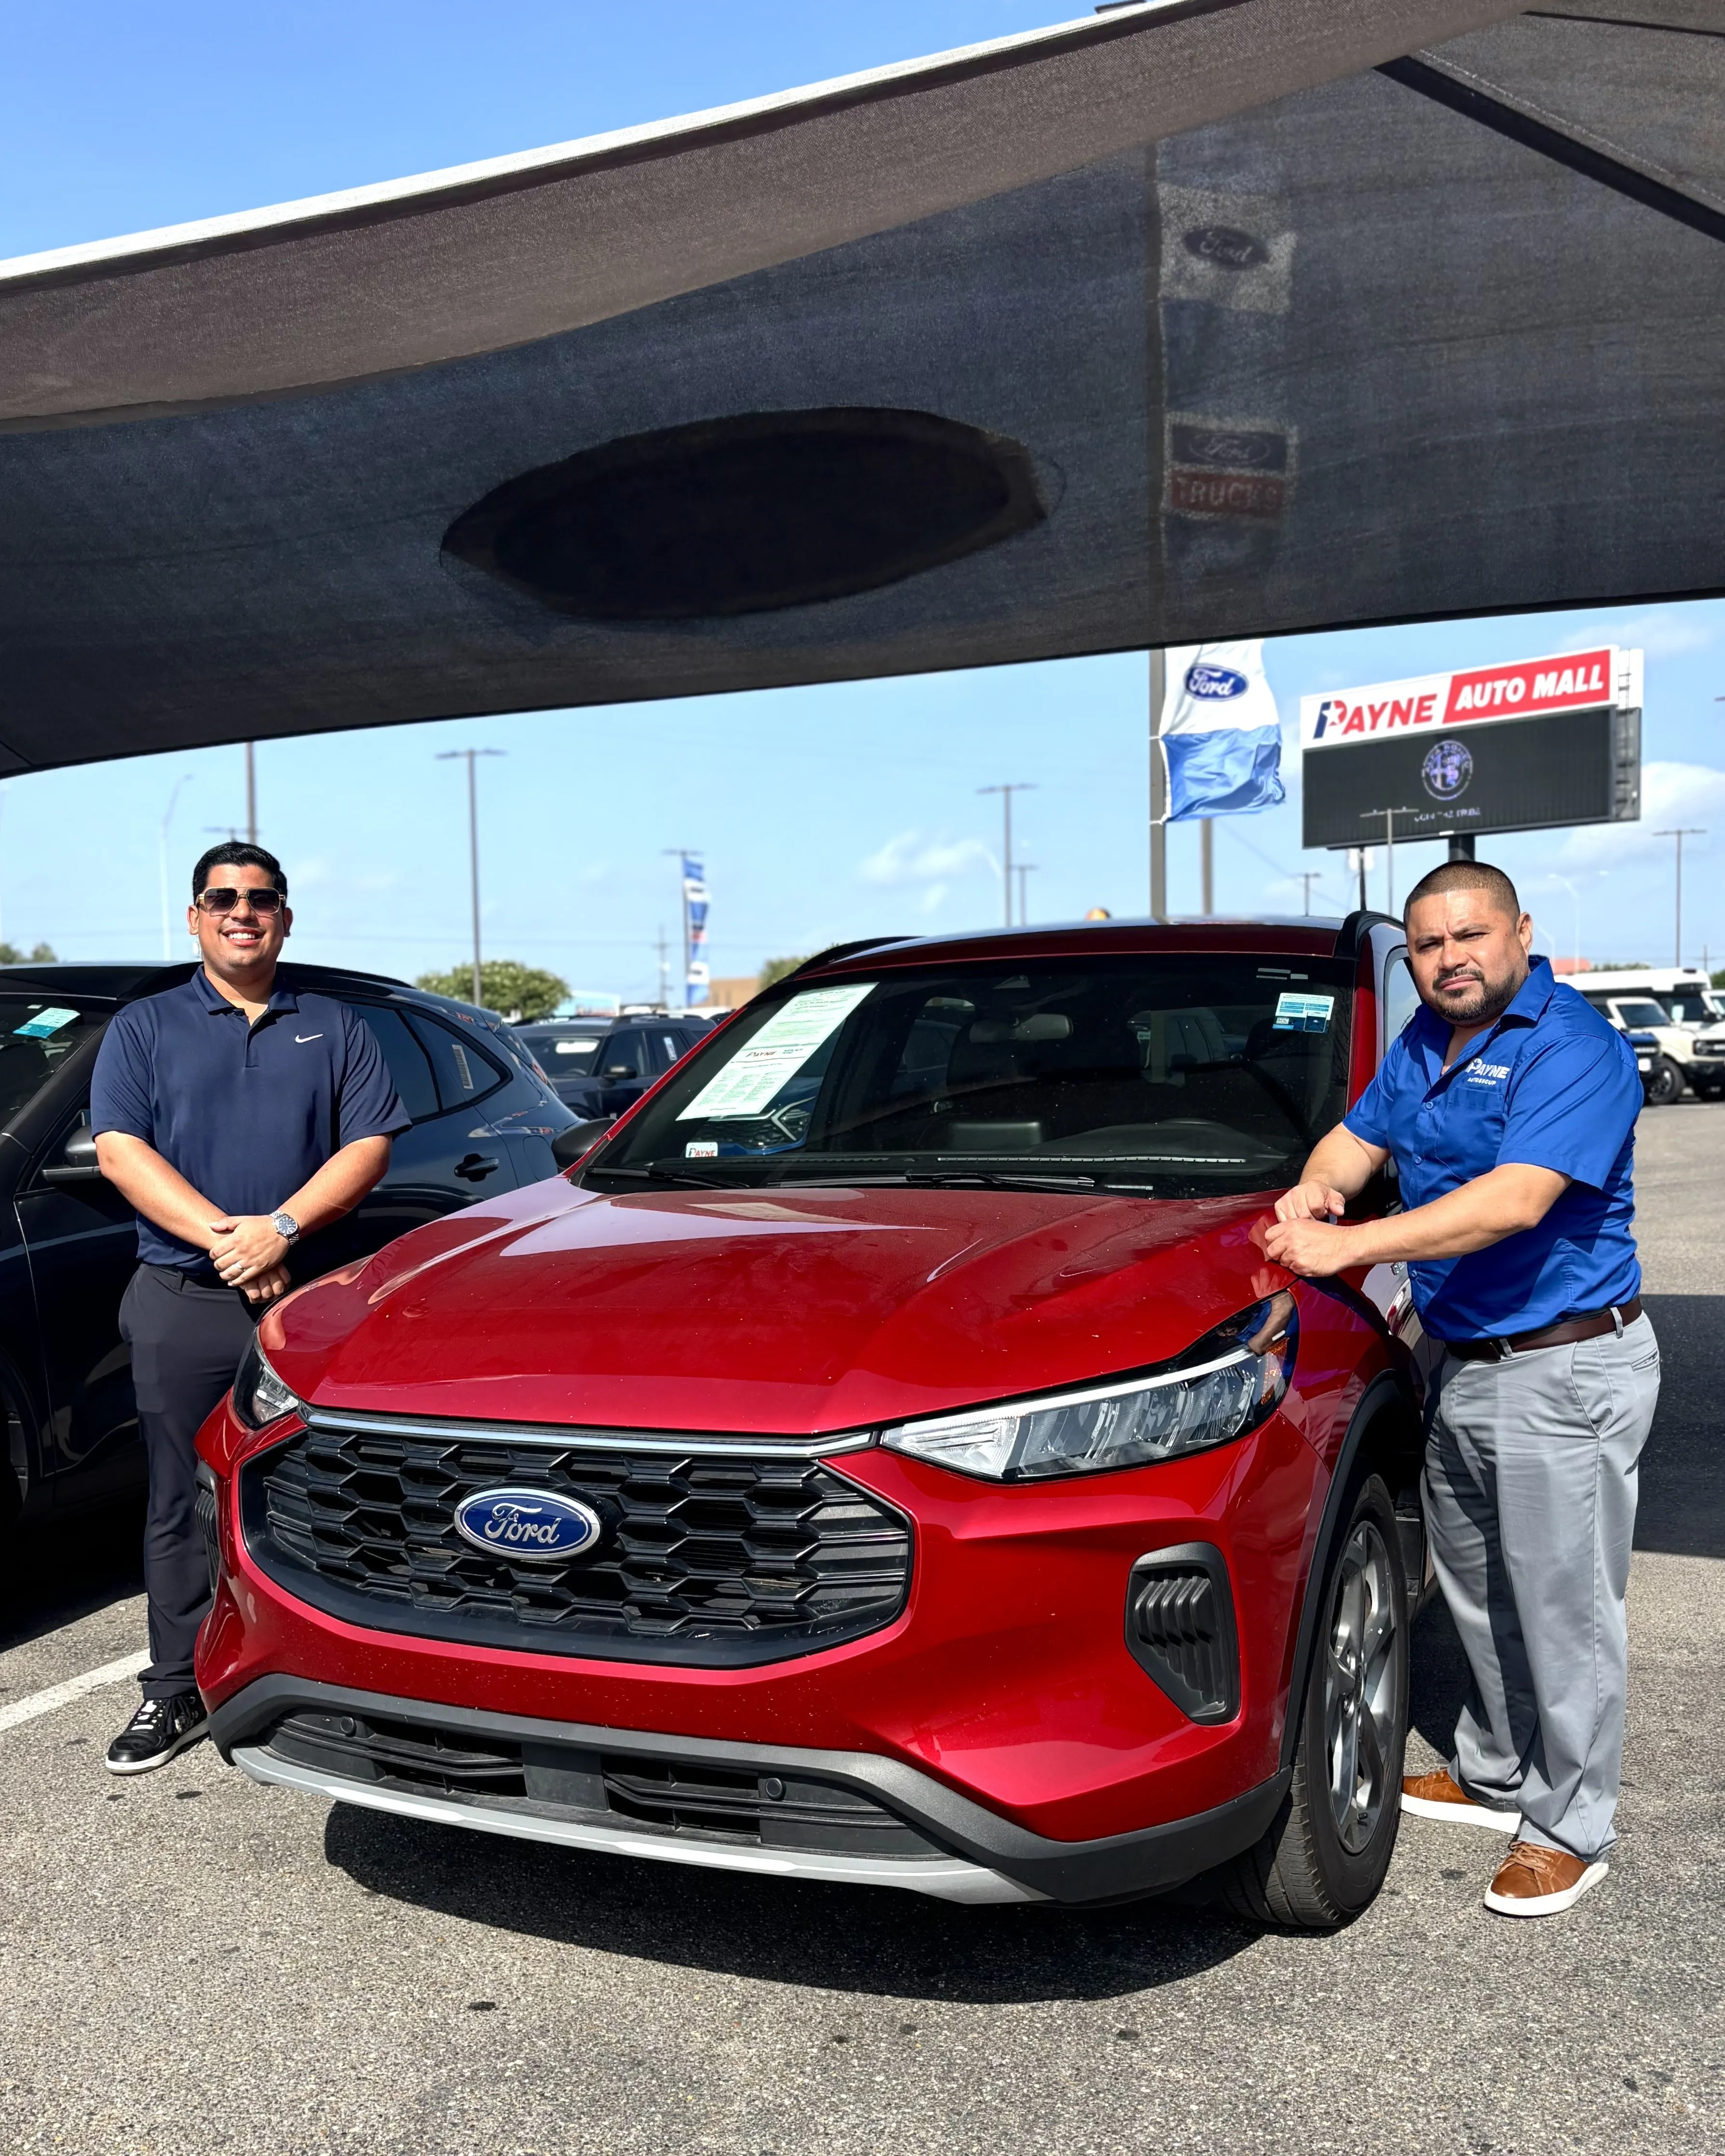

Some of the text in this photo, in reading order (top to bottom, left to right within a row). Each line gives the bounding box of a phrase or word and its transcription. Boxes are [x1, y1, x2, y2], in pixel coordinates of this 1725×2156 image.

[1189, 668, 1236, 696] Ford
[1313, 664, 1603, 740] PAYNE AUTO MALL
[1465, 1058, 1510, 1078] PAYNE
[689, 1148, 715, 1157] PAYNE
[484, 1503, 562, 1544] Ford
